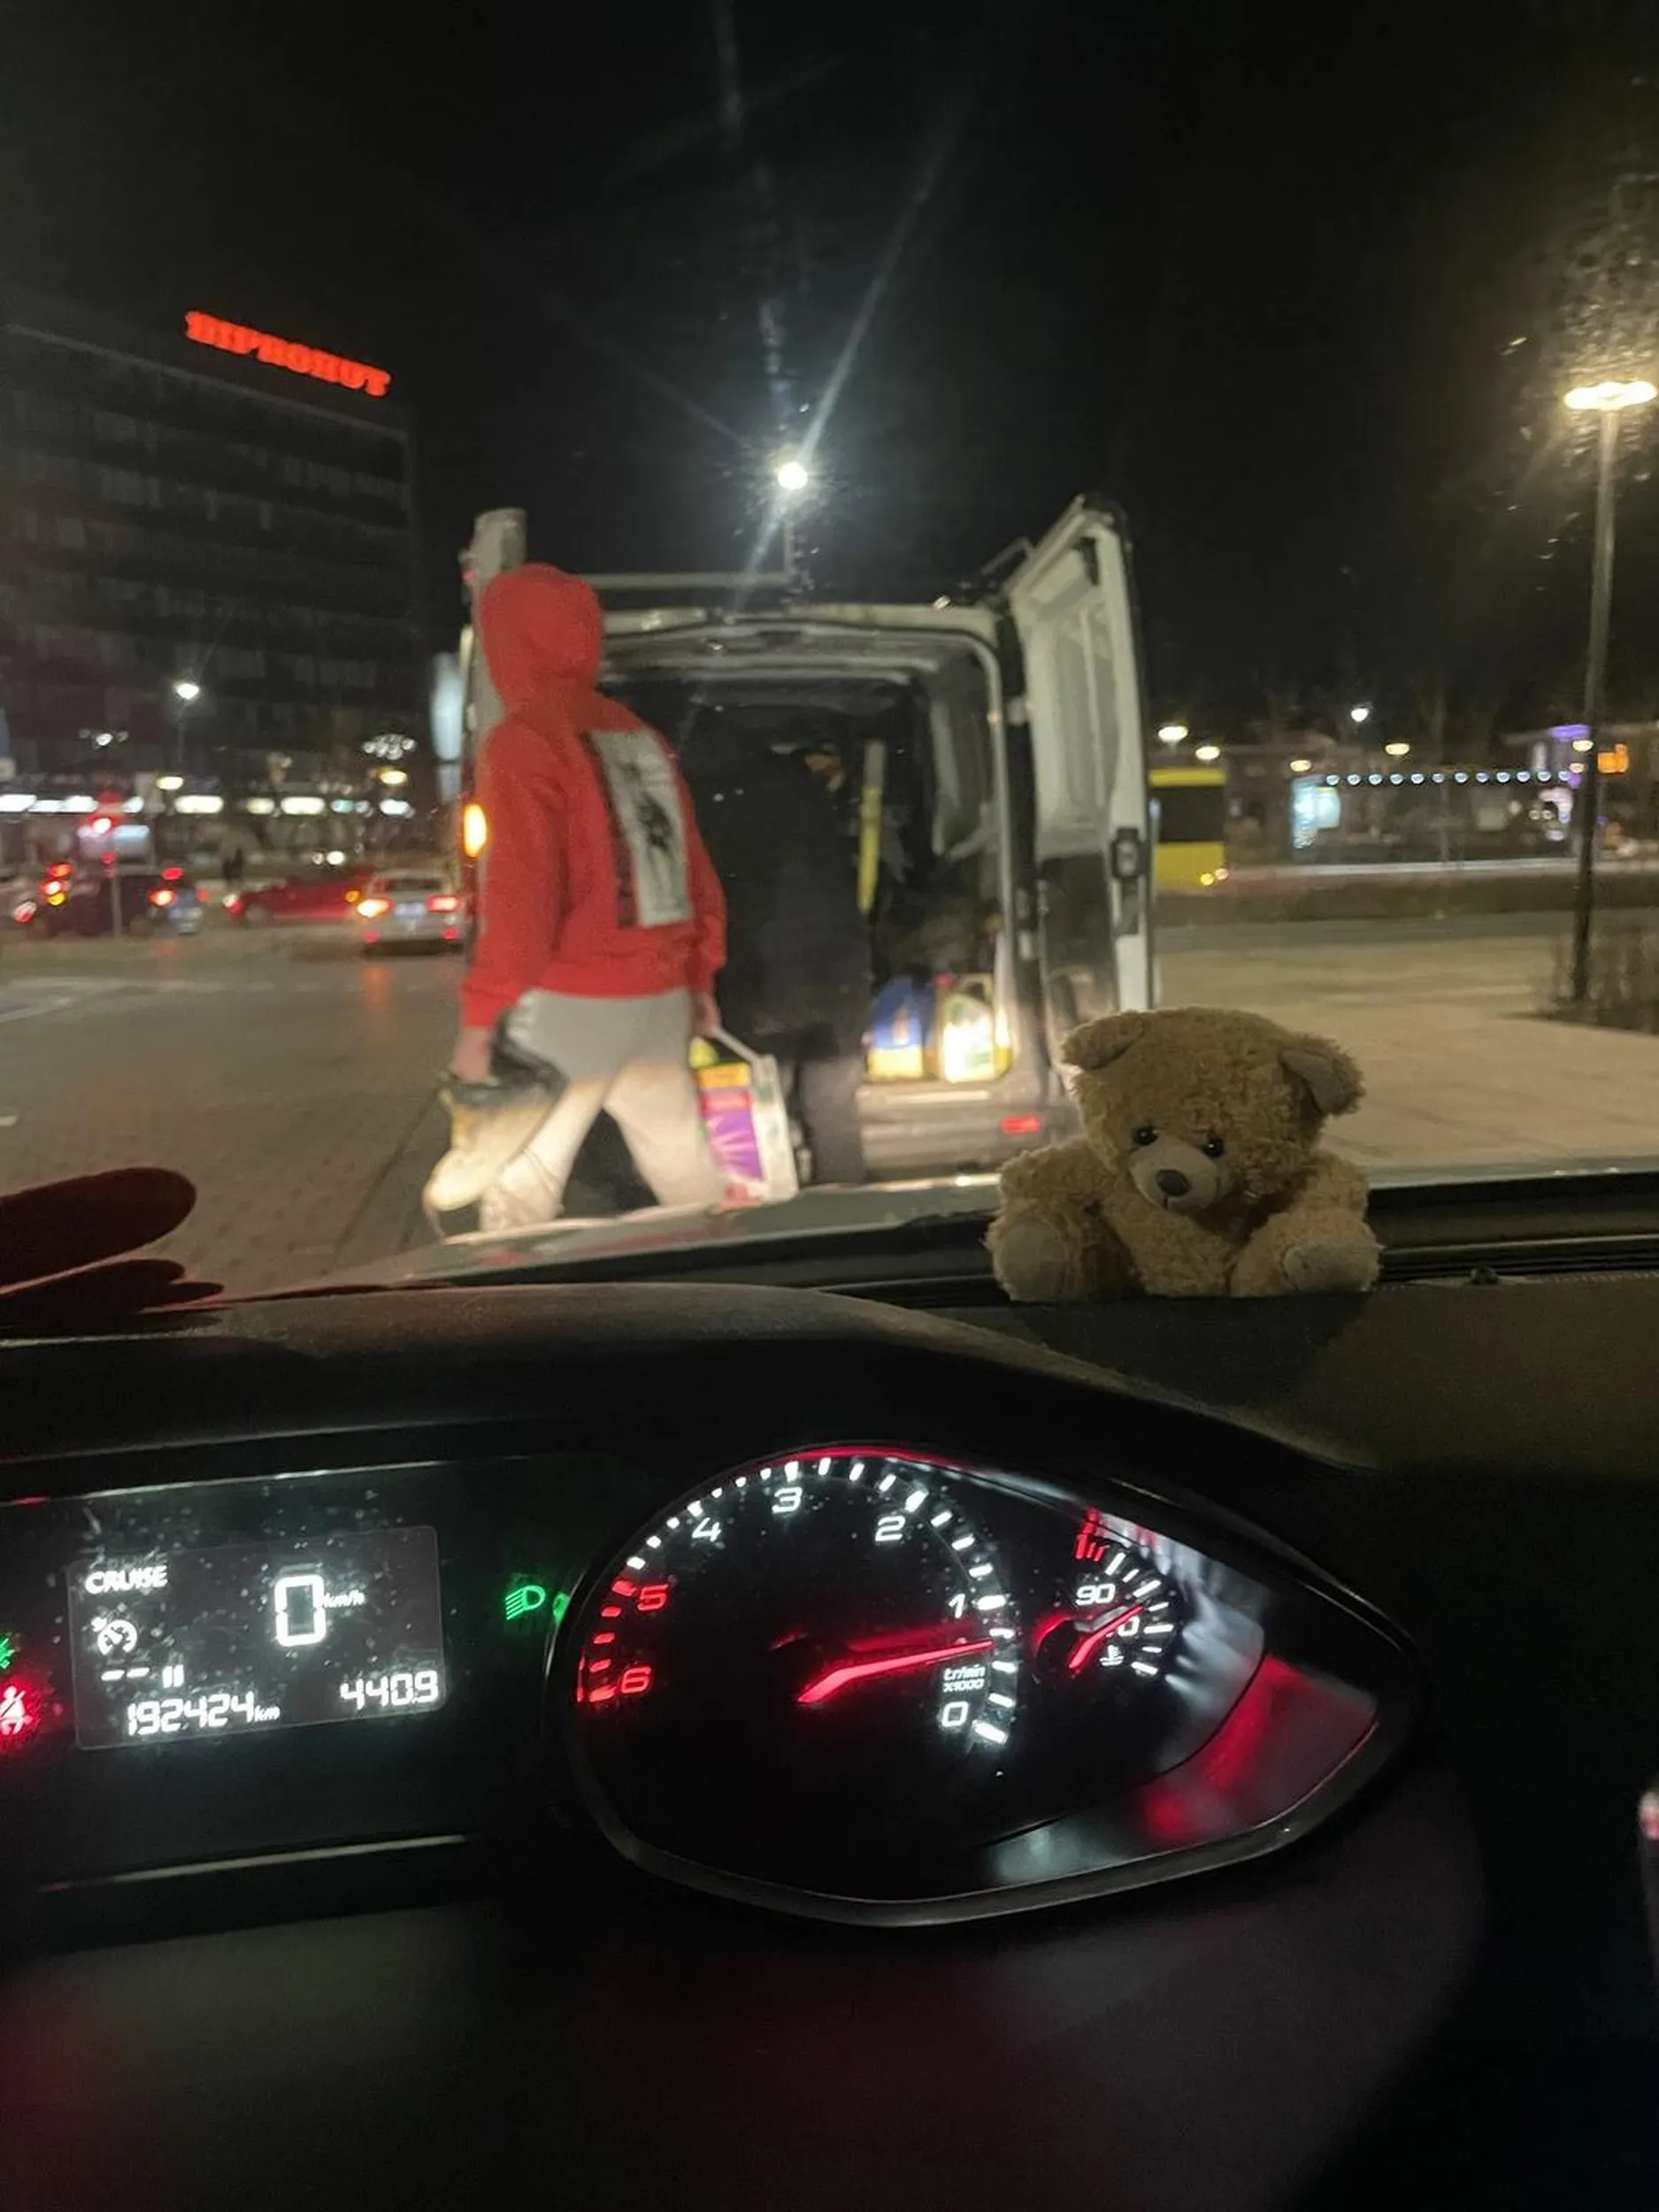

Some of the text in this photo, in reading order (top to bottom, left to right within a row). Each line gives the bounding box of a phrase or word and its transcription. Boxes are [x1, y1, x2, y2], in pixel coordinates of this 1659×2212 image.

[772, 1486, 803, 1515] 3
[691, 1517, 722, 1543] 4
[874, 1515, 906, 1542] 2
[85, 1564, 169, 1594] CRUISE
[637, 1584, 669, 1611] 5
[949, 1594, 965, 1619] 1
[1076, 1583, 1117, 1606] 90
[274, 1575, 326, 1647] 0
[621, 1666, 652, 1694] 6
[127, 1691, 280, 1736] 192424 km
[941, 1701, 969, 1727] 0
